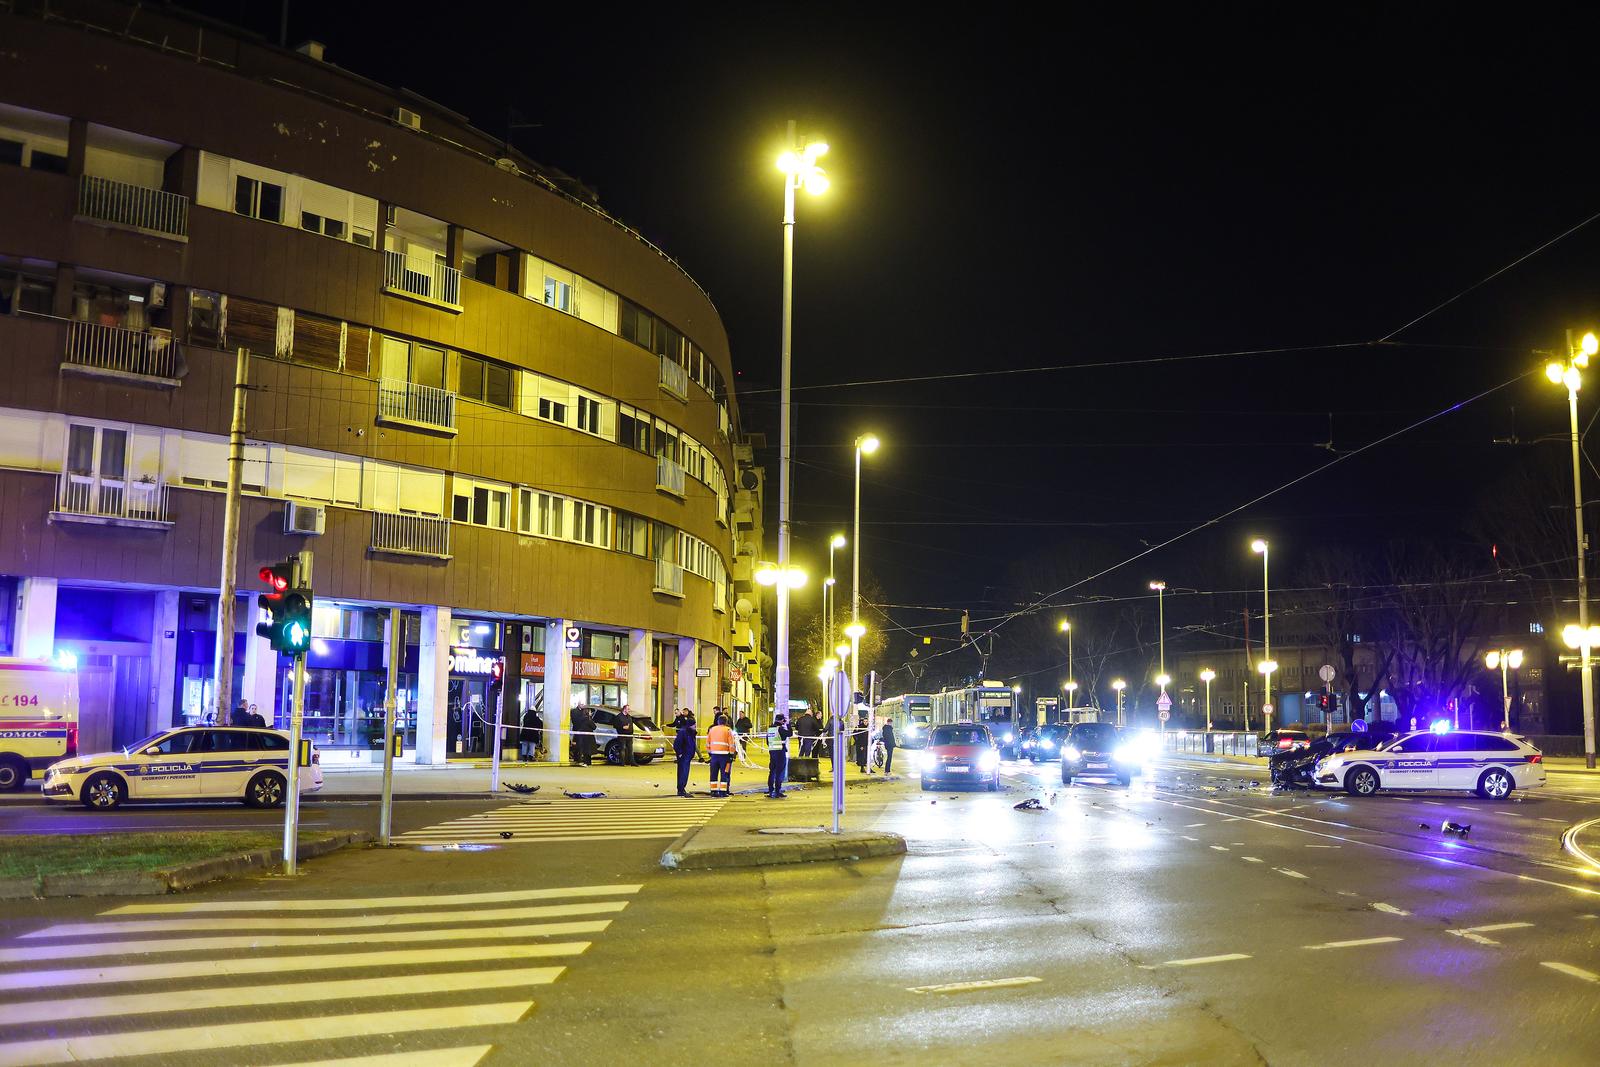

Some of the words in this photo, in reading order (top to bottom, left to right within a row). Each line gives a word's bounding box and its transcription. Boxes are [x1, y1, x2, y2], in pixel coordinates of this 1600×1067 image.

[574, 661, 600, 677] RESTORAN
[12, 695, 38, 706] 194
[151, 764, 193, 773] POLICIJA
